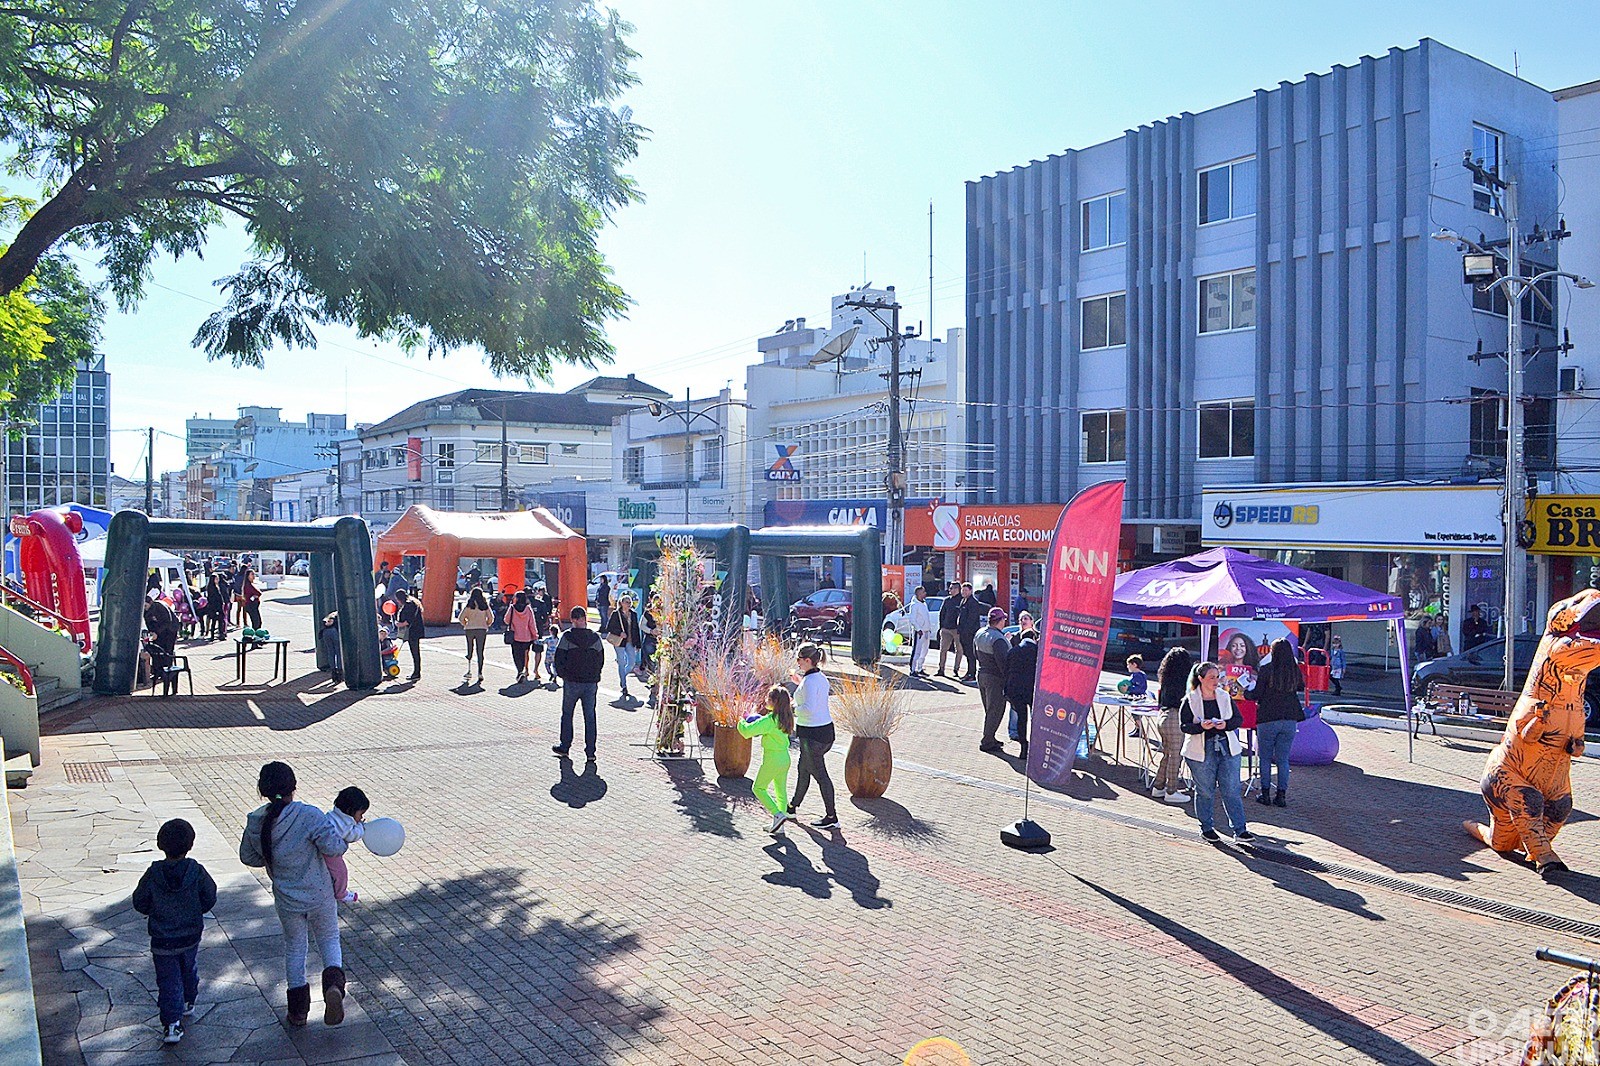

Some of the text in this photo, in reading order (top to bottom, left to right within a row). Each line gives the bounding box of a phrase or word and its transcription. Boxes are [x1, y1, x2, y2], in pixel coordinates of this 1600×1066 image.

[769, 471, 799, 480] CAIXA
[828, 507, 878, 526] CAIXA
[1546, 503, 1597, 518] Casa
[965, 512, 1021, 527] FARMÁCIAS
[663, 534, 694, 548] SICOOB
[965, 529, 1000, 541] SANTA
[1060, 546, 1109, 577] KNN
[1063, 573, 1102, 585] IDIOMAS
[1256, 577, 1320, 595] KNN
[1060, 625, 1098, 638] NOVO IDIOMA
